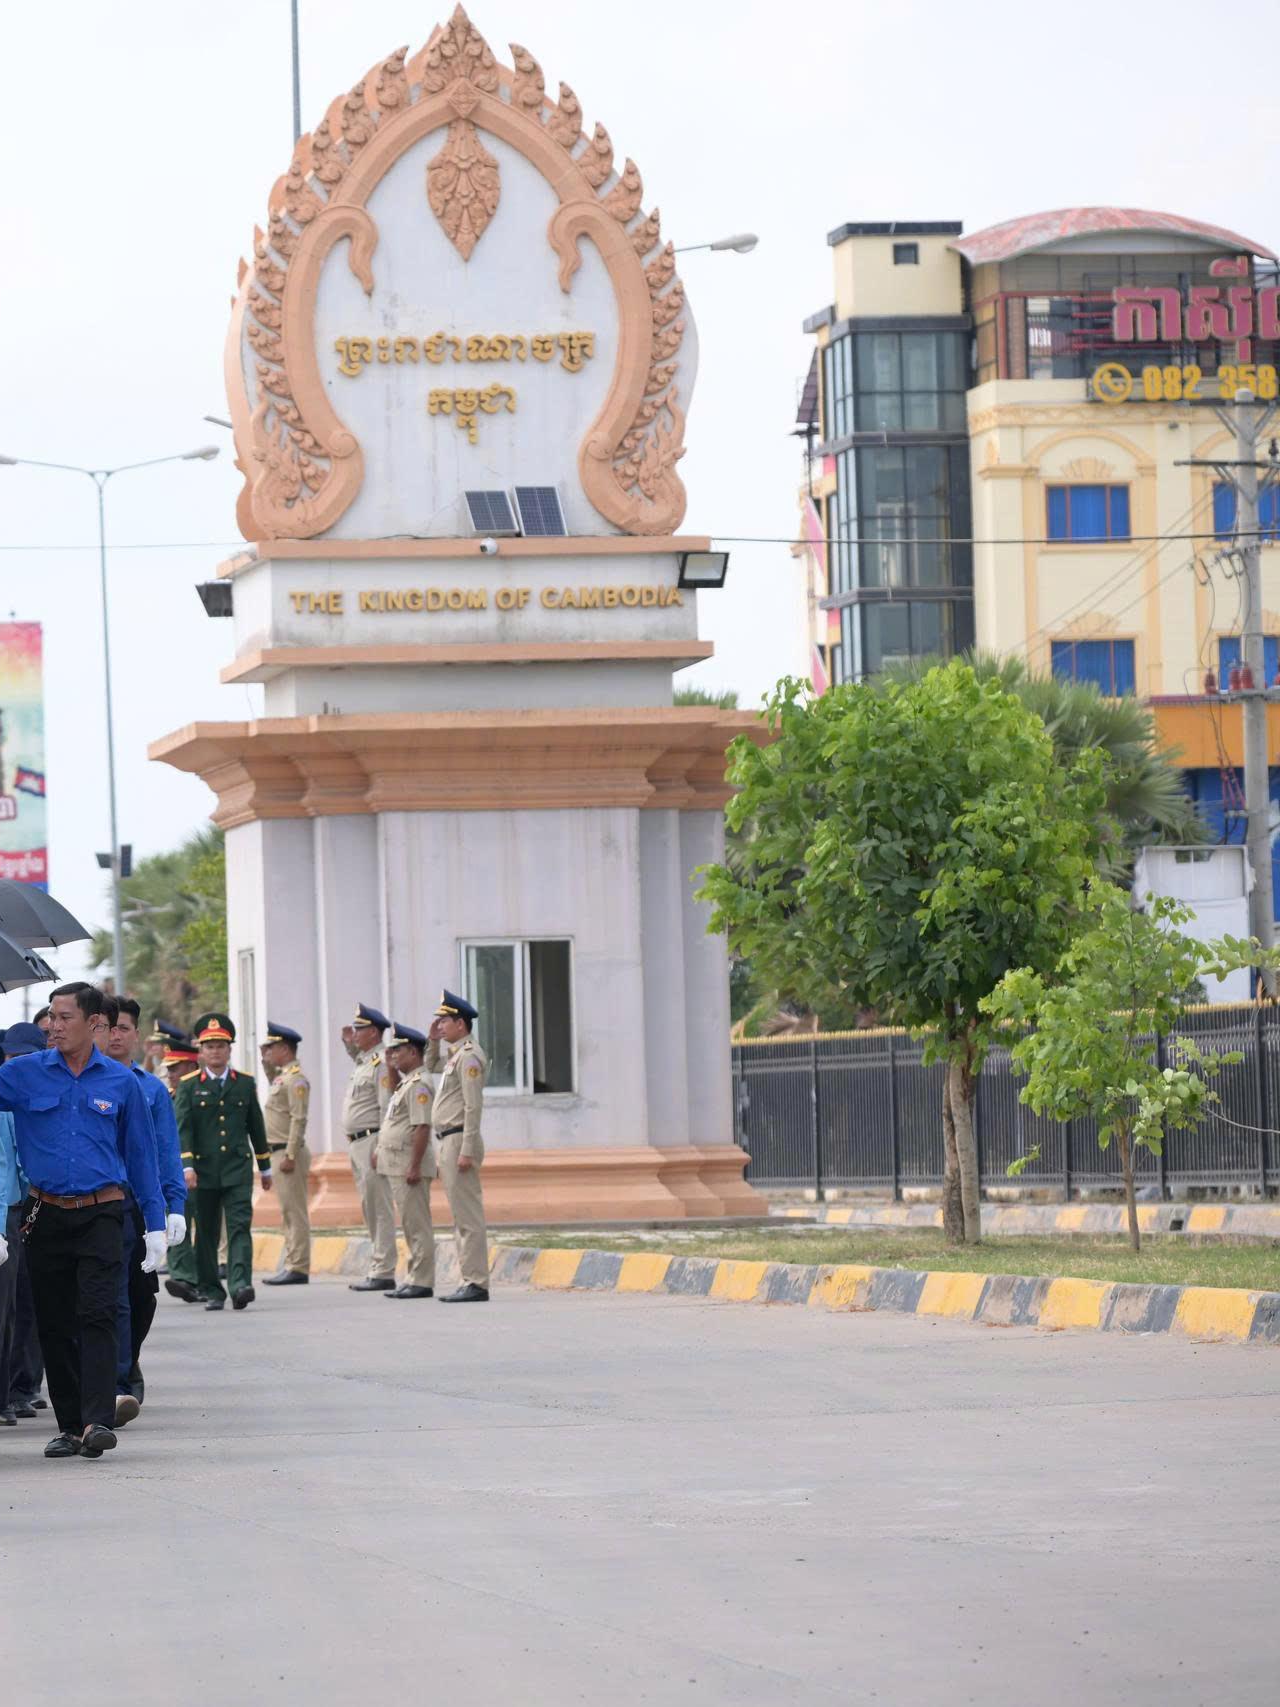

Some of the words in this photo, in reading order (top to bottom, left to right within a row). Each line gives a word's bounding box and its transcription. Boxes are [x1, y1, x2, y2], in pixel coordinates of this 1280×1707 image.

[1142, 364, 1202, 401] 082
[1218, 364, 1277, 400] 358
[289, 590, 344, 614] THE
[359, 586, 488, 613] KINGDOM
[496, 587, 531, 611] OF
[540, 584, 684, 610] CAMBODIA
